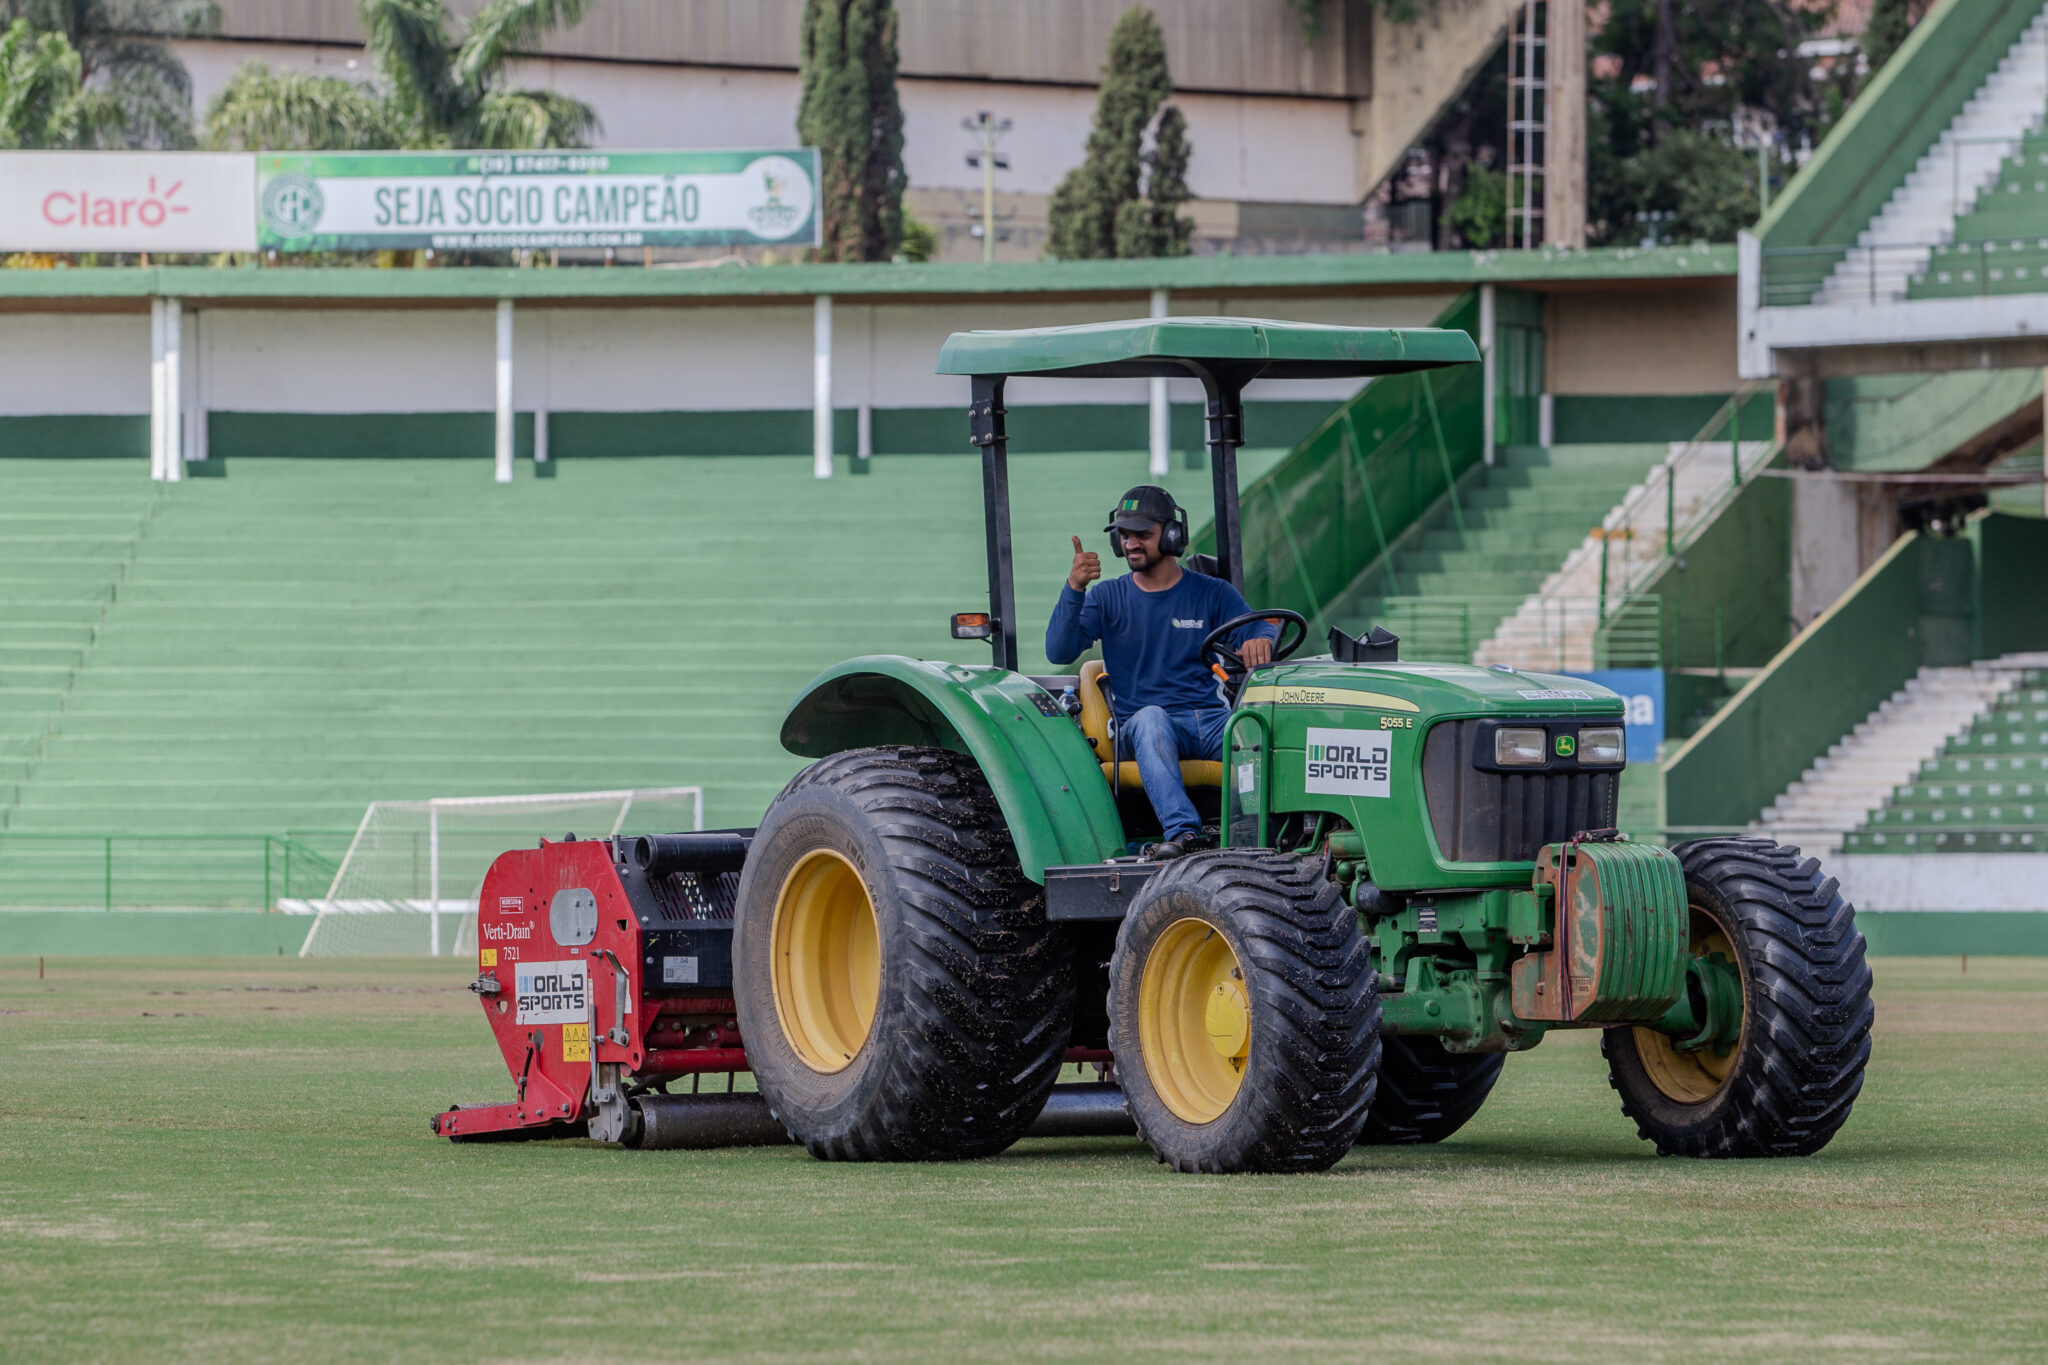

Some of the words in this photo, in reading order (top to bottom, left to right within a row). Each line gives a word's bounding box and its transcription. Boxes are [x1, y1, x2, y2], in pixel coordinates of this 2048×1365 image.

[41, 190, 167, 228] Claro
[374, 184, 446, 226] SEJA
[456, 175, 544, 225] SÓCIO
[554, 174, 700, 225] CAMPEÃO
[1280, 689, 1299, 703] JOHN
[1300, 689, 1325, 703] DEERE
[1380, 716, 1404, 730] 5055
[1405, 718, 1413, 729] E
[1308, 744, 1388, 764] WORLD
[1308, 763, 1388, 781] SPORTS
[503, 946, 520, 961] 7521
[518, 973, 584, 994] WORLD
[519, 993, 585, 1011] SPORTS
